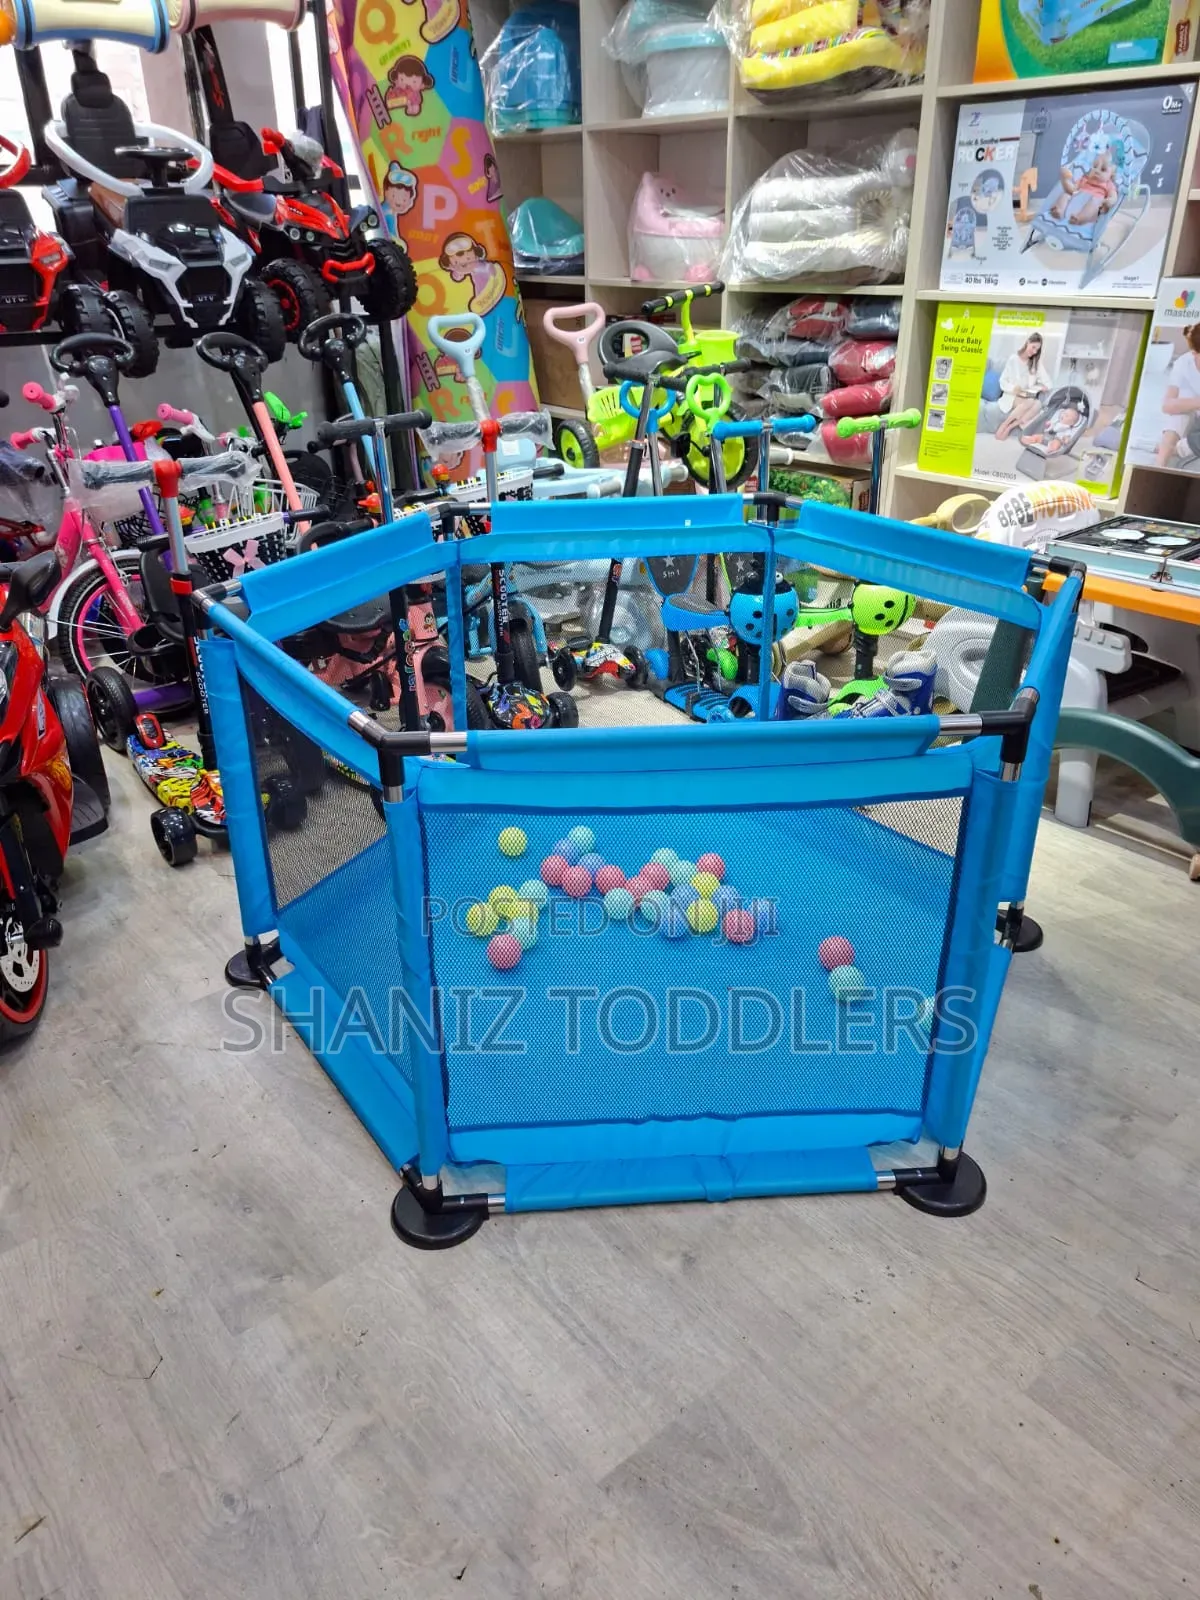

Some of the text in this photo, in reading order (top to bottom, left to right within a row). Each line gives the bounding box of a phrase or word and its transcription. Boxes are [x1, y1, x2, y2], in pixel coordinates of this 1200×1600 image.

[422, 184, 458, 230] P
[1164, 308, 1200, 318] mastela
[943, 335, 982, 346] Deluxe Baby
[940, 344, 983, 354] Swing Classic
[195, 671, 209, 714] SCOOTER
